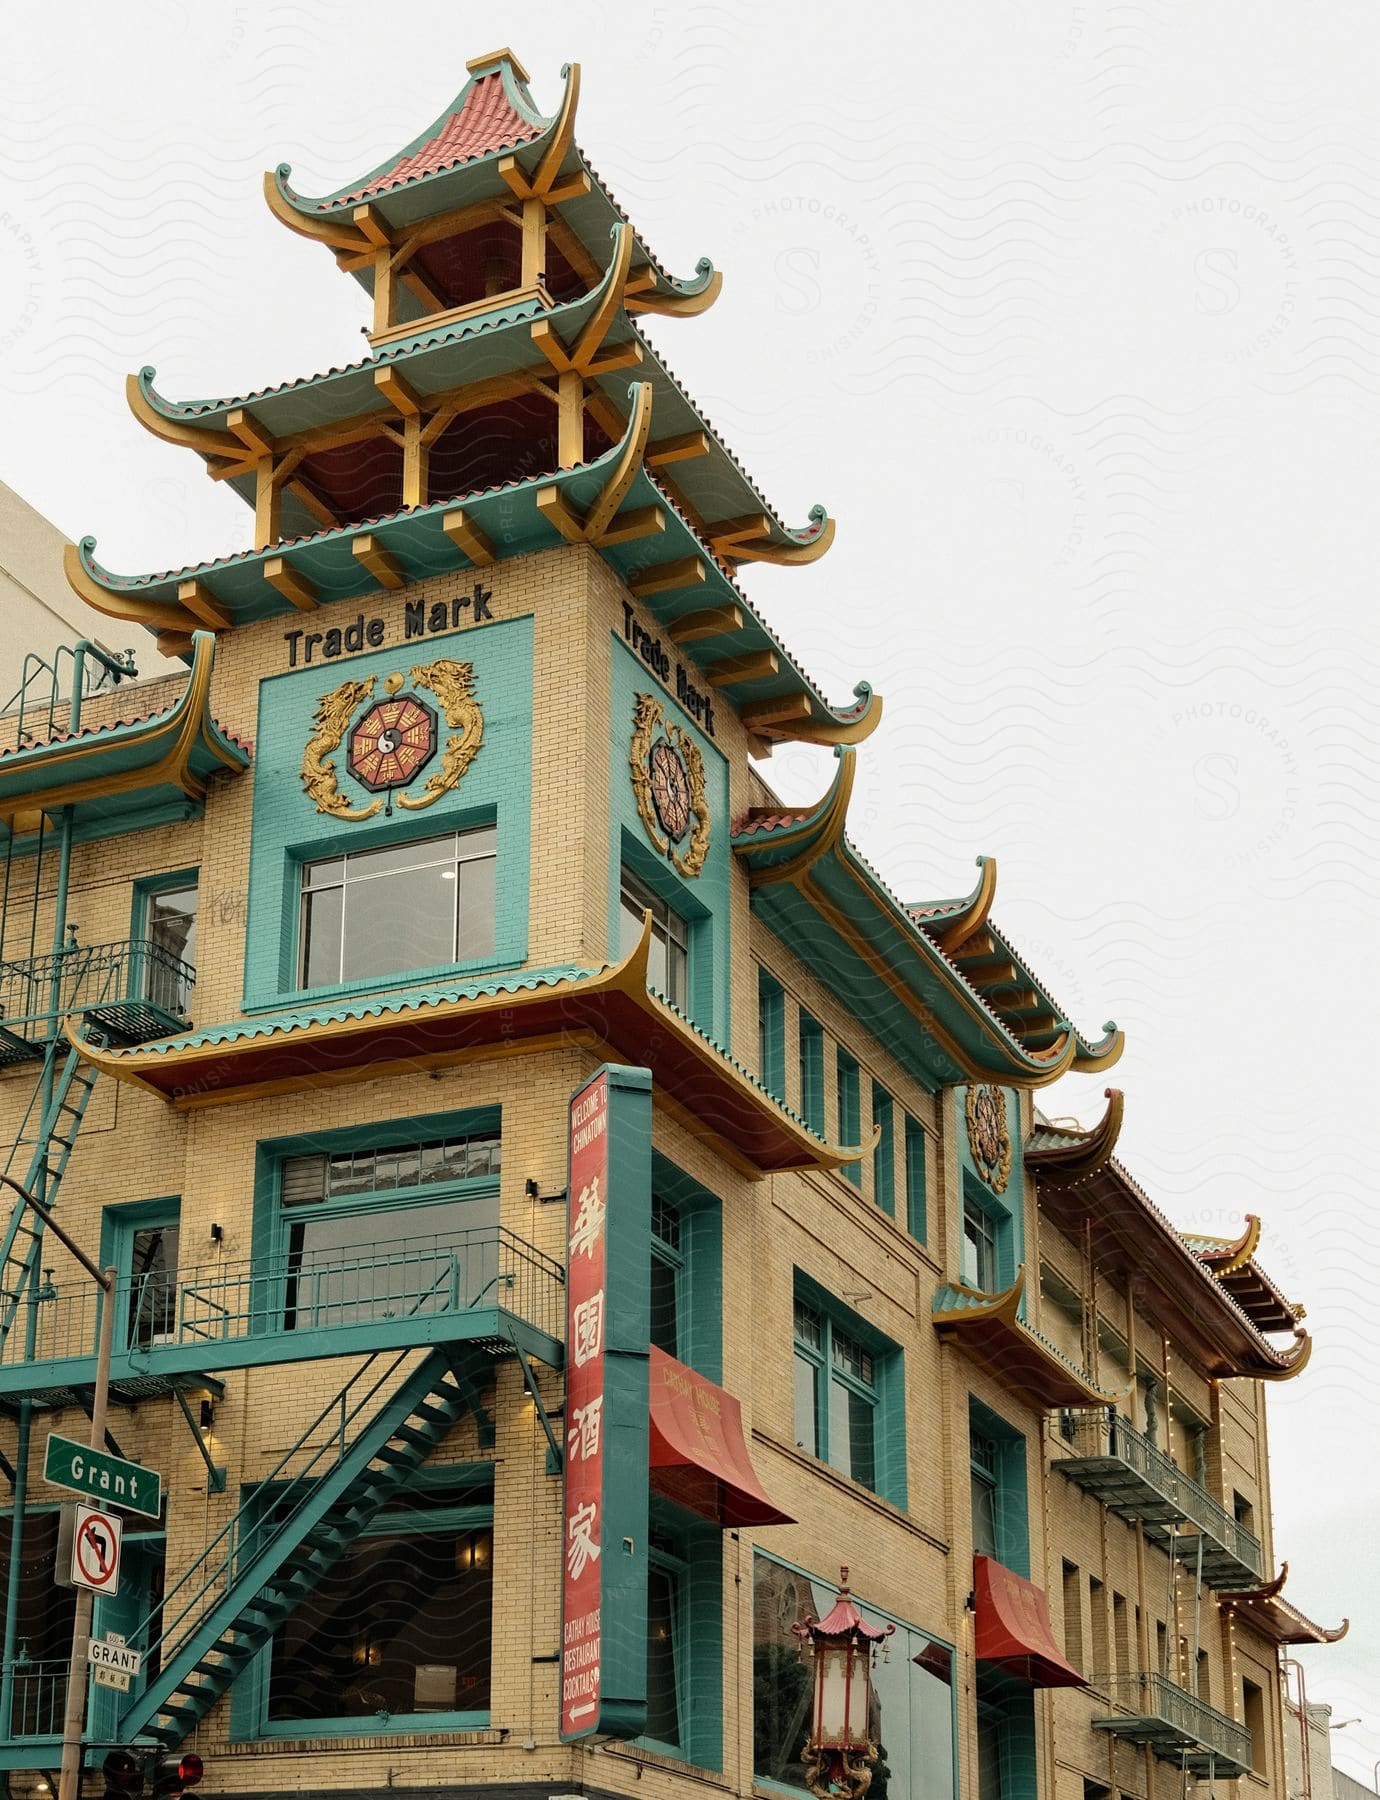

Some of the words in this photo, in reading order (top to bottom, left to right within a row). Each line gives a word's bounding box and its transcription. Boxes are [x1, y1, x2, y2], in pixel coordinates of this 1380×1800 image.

[284, 614, 385, 667] Trade
[404, 584, 493, 639] Mark
[622, 600, 670, 683] Trade
[676, 663, 715, 737] Mark
[571, 1090, 599, 1130] WELCOME
[600, 1084, 608, 1105] TO
[573, 1109, 607, 1154] CHINATOWN
[71, 1455, 138, 1499] Grant
[563, 1616, 586, 1645] CATHAY
[92, 1644, 138, 1670] GRANT
[563, 1638, 600, 1673] RESTAURANT
[562, 1668, 595, 1702] COCKTAILS
